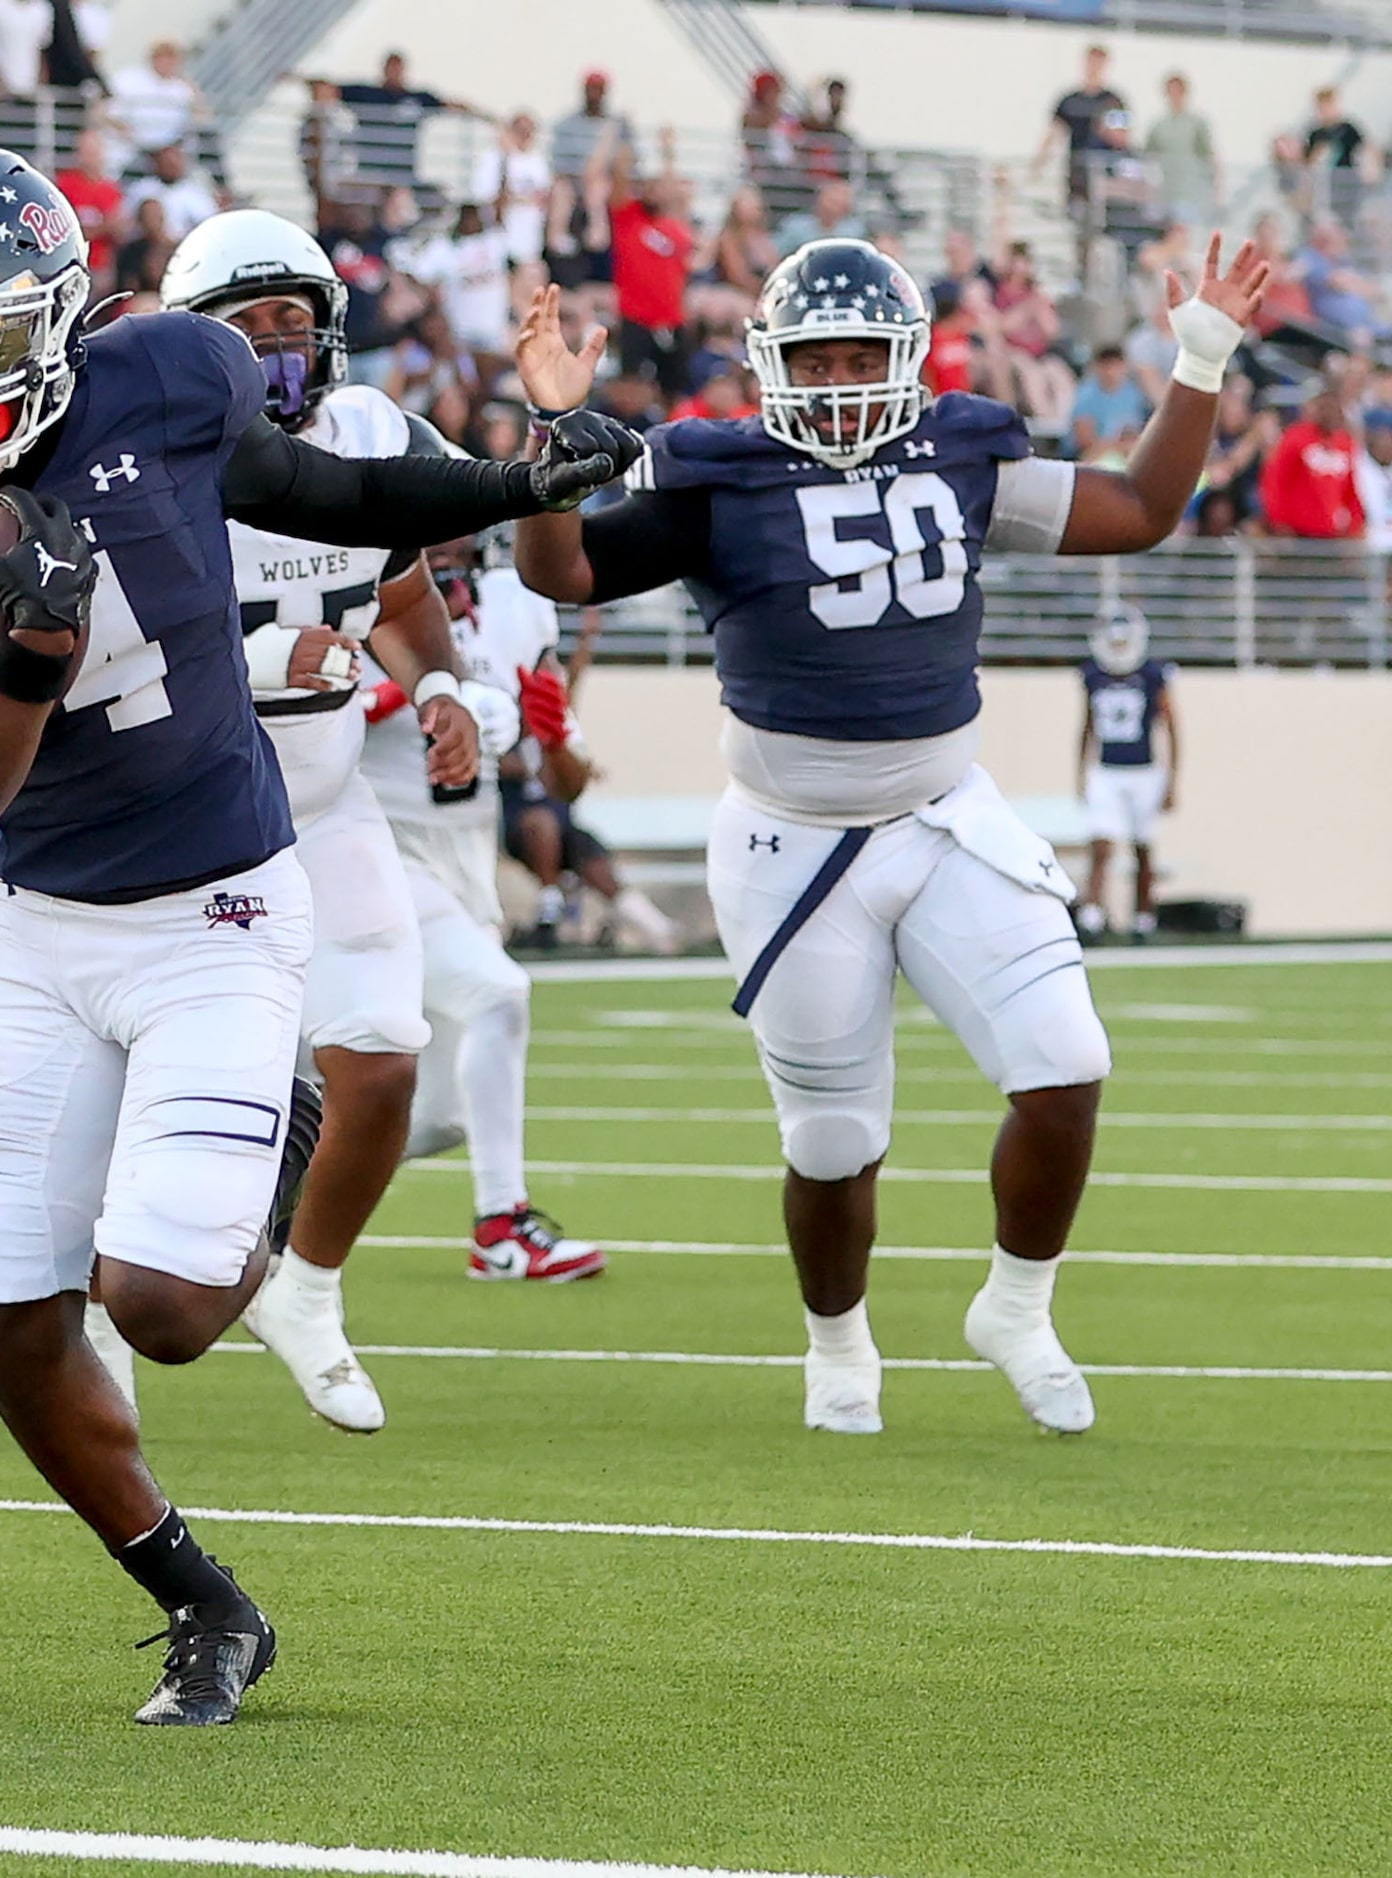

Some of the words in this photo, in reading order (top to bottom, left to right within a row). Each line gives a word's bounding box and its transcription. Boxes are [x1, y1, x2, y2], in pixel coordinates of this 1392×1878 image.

[259, 551, 349, 582] WOLVES
[794, 472, 969, 630] 50
[62, 549, 174, 733] 4
[207, 898, 264, 917] RYAN
